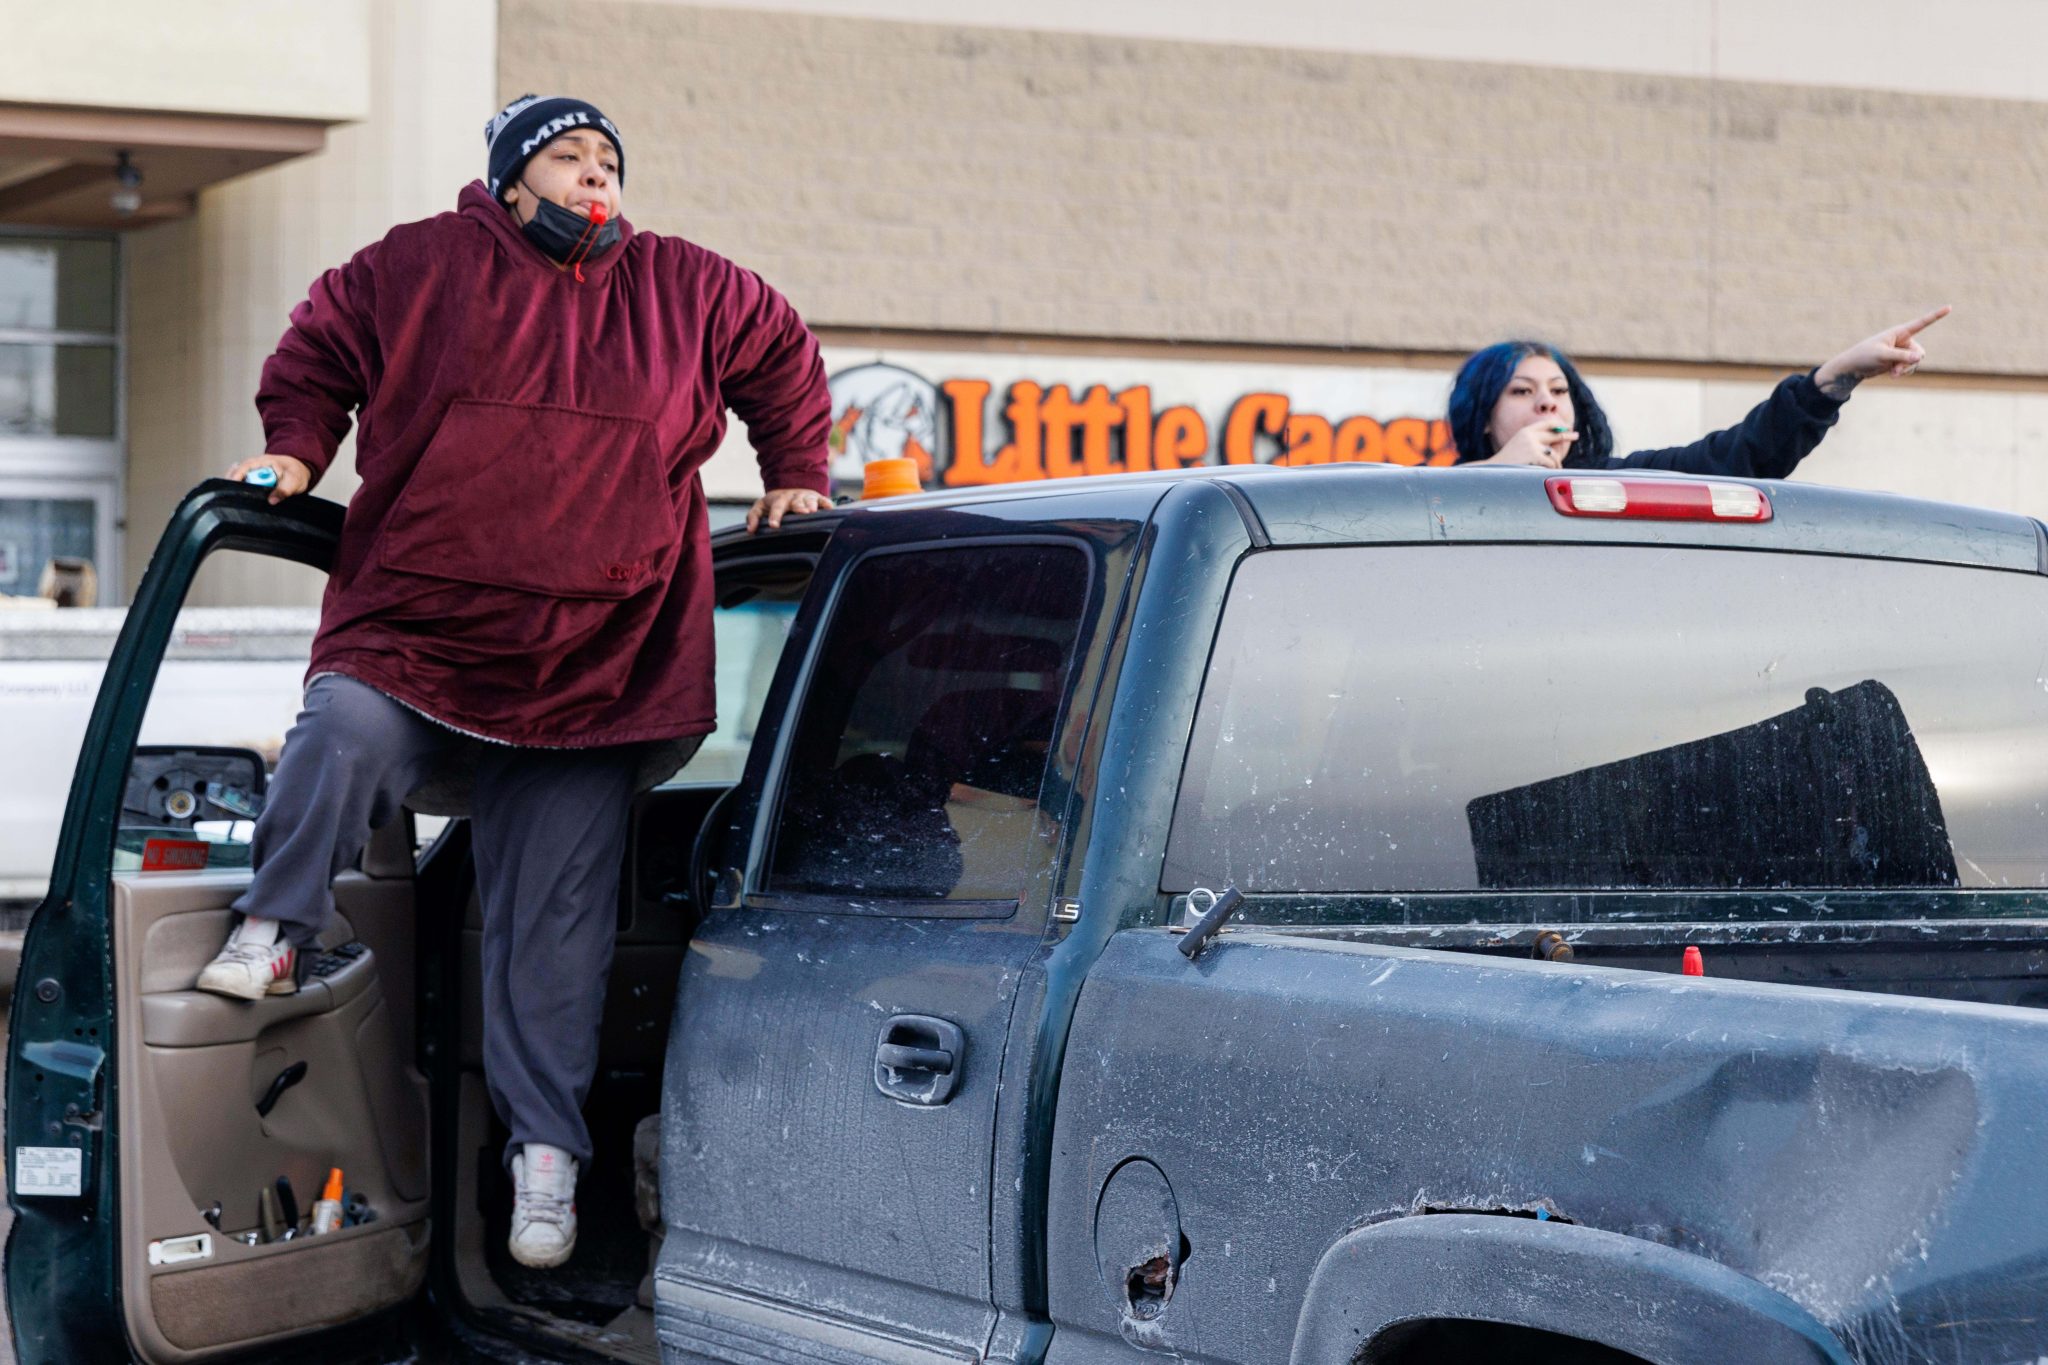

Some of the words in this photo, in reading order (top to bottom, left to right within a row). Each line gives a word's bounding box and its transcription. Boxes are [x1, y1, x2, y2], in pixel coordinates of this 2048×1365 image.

[521, 112, 590, 155] MNI
[943, 379, 1208, 486] Little
[1052, 902, 1080, 920] LS
